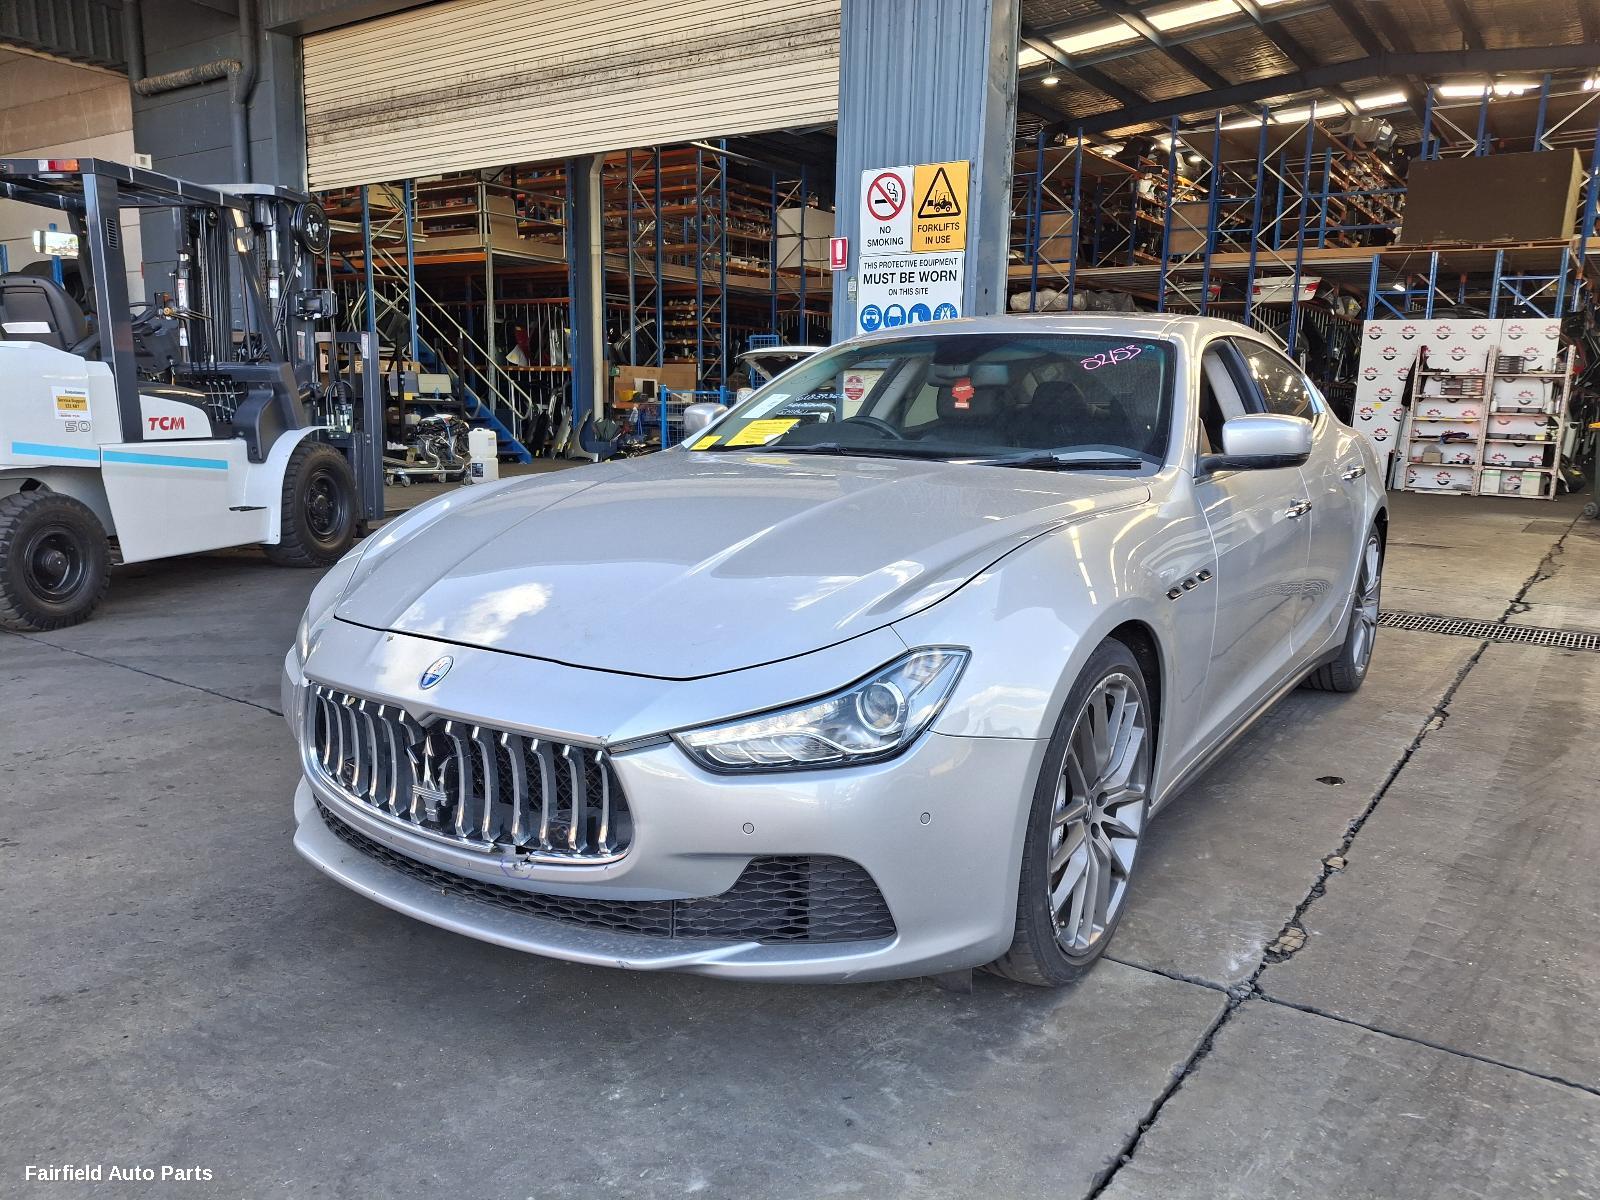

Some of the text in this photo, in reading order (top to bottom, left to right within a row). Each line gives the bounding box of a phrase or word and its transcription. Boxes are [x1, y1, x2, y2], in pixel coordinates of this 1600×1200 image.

[879, 226, 892, 234] NO
[917, 222, 960, 232] FORKLIFTS
[867, 237, 904, 246] SMOKING
[935, 235, 950, 244] USE
[879, 260, 918, 268] PROTECTIVE
[919, 258, 958, 266] EQUIPMENT
[863, 270, 958, 284] MUST BE WORN
[64, 420, 91, 433] 50
[148, 416, 185, 431] TCM
